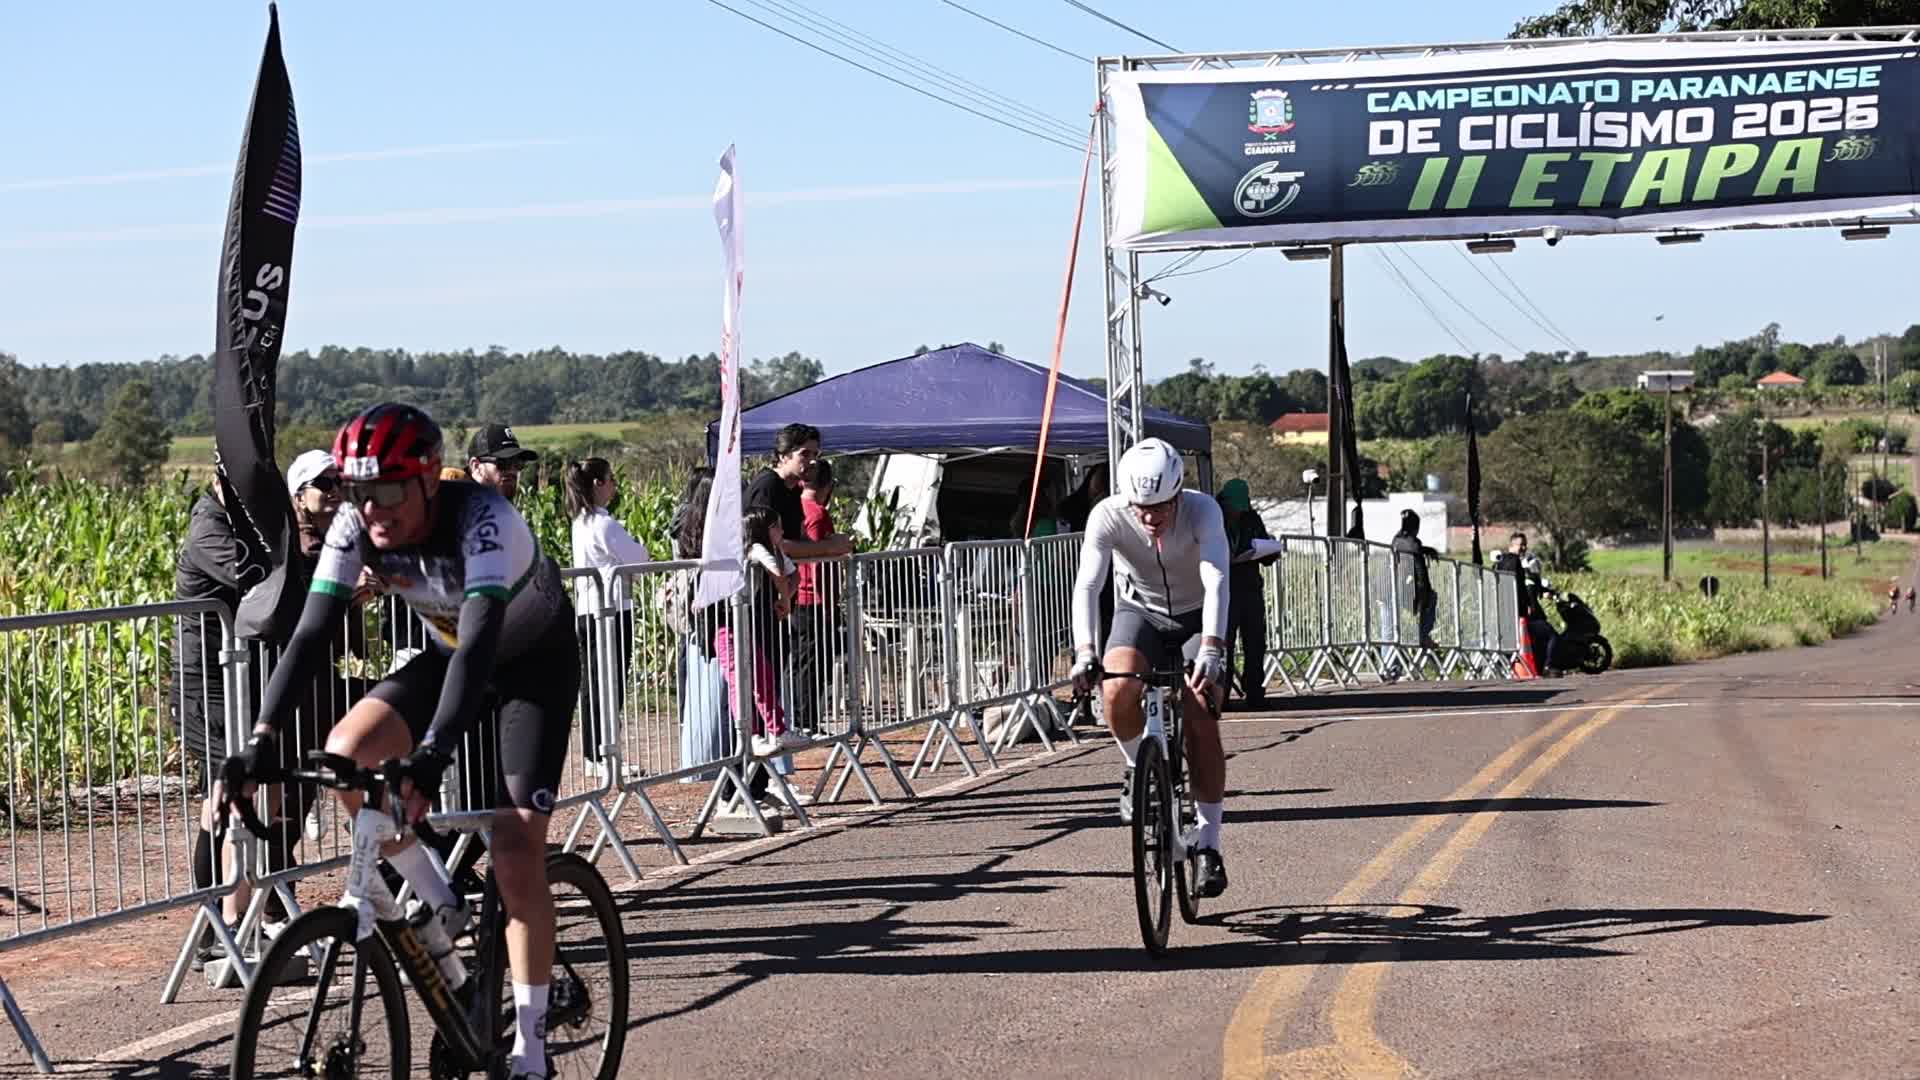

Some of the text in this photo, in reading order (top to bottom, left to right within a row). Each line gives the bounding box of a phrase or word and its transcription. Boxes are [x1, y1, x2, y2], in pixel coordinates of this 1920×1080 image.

[1367, 65, 1882, 113] CAMPEONATO PARANAENSE
[1244, 144, 1296, 155] CIANORTE
[1368, 117, 1441, 155] DE
[1459, 101, 1715, 150] CICLÍSMO
[1407, 137, 1823, 211] II ETAPA
